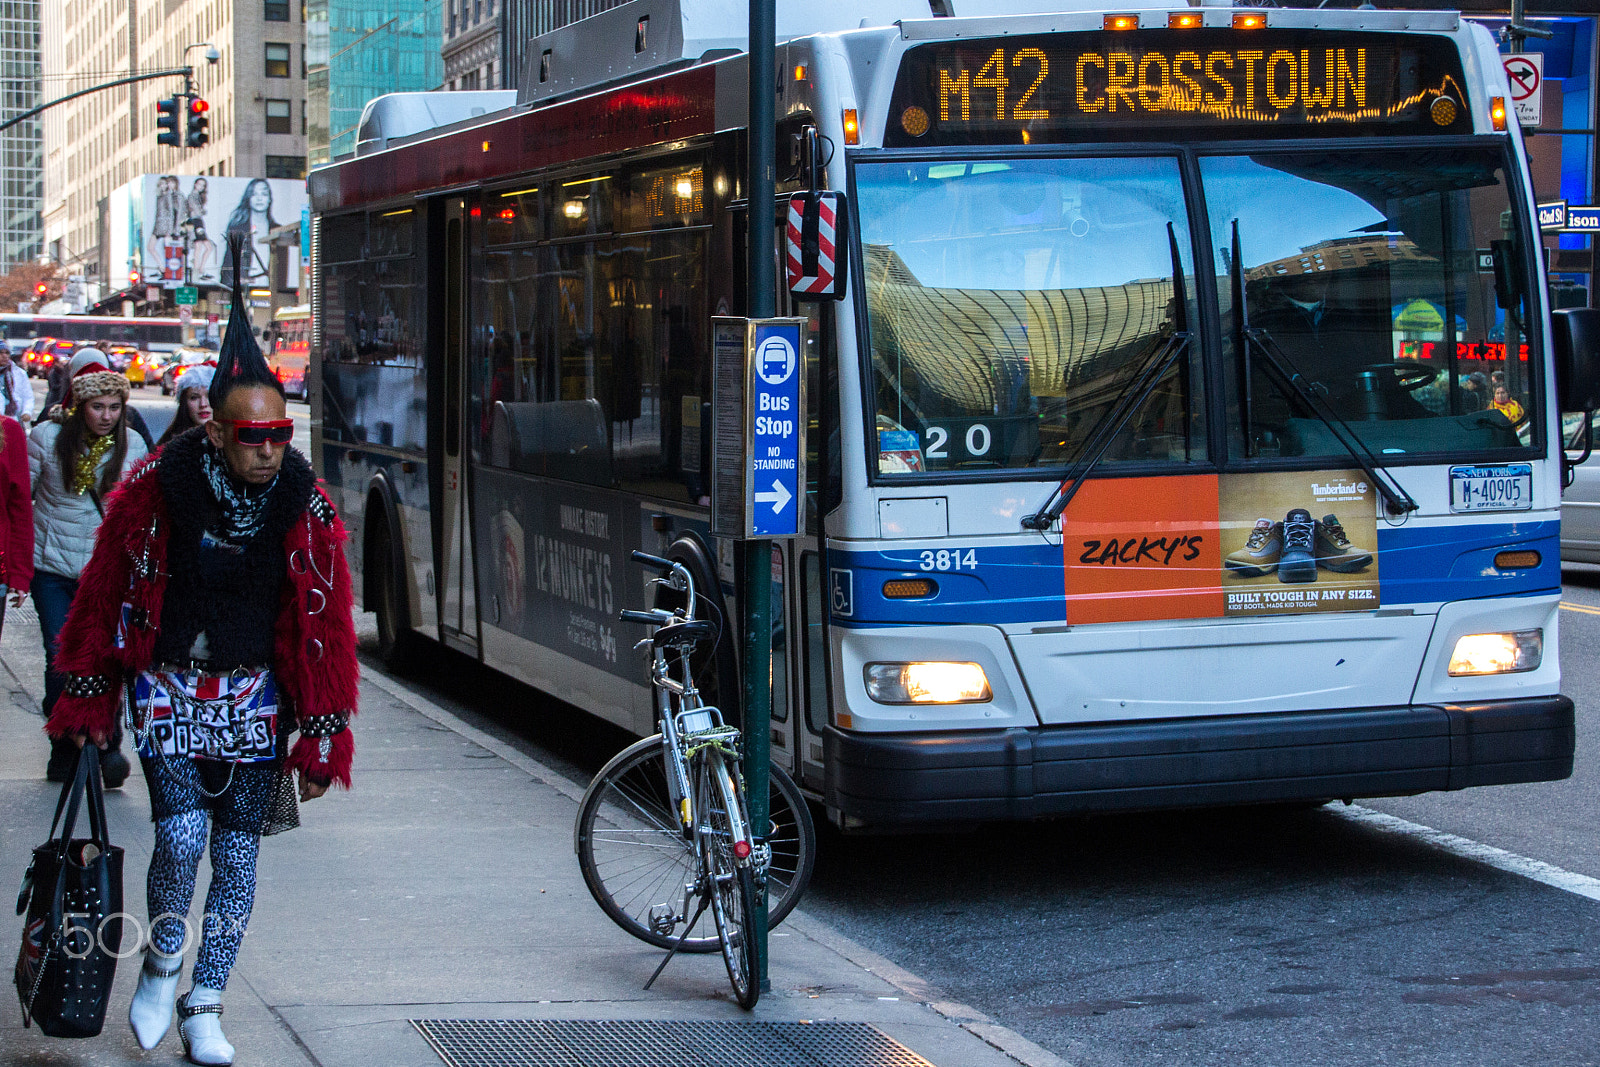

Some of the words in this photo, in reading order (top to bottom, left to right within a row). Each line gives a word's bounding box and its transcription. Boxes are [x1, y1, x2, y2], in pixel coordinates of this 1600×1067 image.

[939, 47, 1049, 121] M42
[1075, 48, 1366, 113] CROSSTOWN
[1539, 208, 1554, 224] 42nd
[1555, 207, 1563, 223] St
[759, 392, 790, 412] Bus
[755, 416, 793, 439] Stop
[767, 446, 781, 457] NO
[753, 458, 796, 470] STANDING
[1470, 468, 1490, 478] NEW
[1490, 467, 1512, 477] YORK
[1311, 482, 1356, 495] Timberland
[1079, 535, 1203, 566] ZACKY'S
[919, 548, 979, 572] 3814
[1227, 592, 1261, 604] BUILT
[1263, 591, 1304, 602] TOUGH
[1306, 590, 1319, 601] IN
[1321, 590, 1346, 601] ANY
[1348, 589, 1376, 600] SIZE.
[1284, 601, 1295, 609] KID
